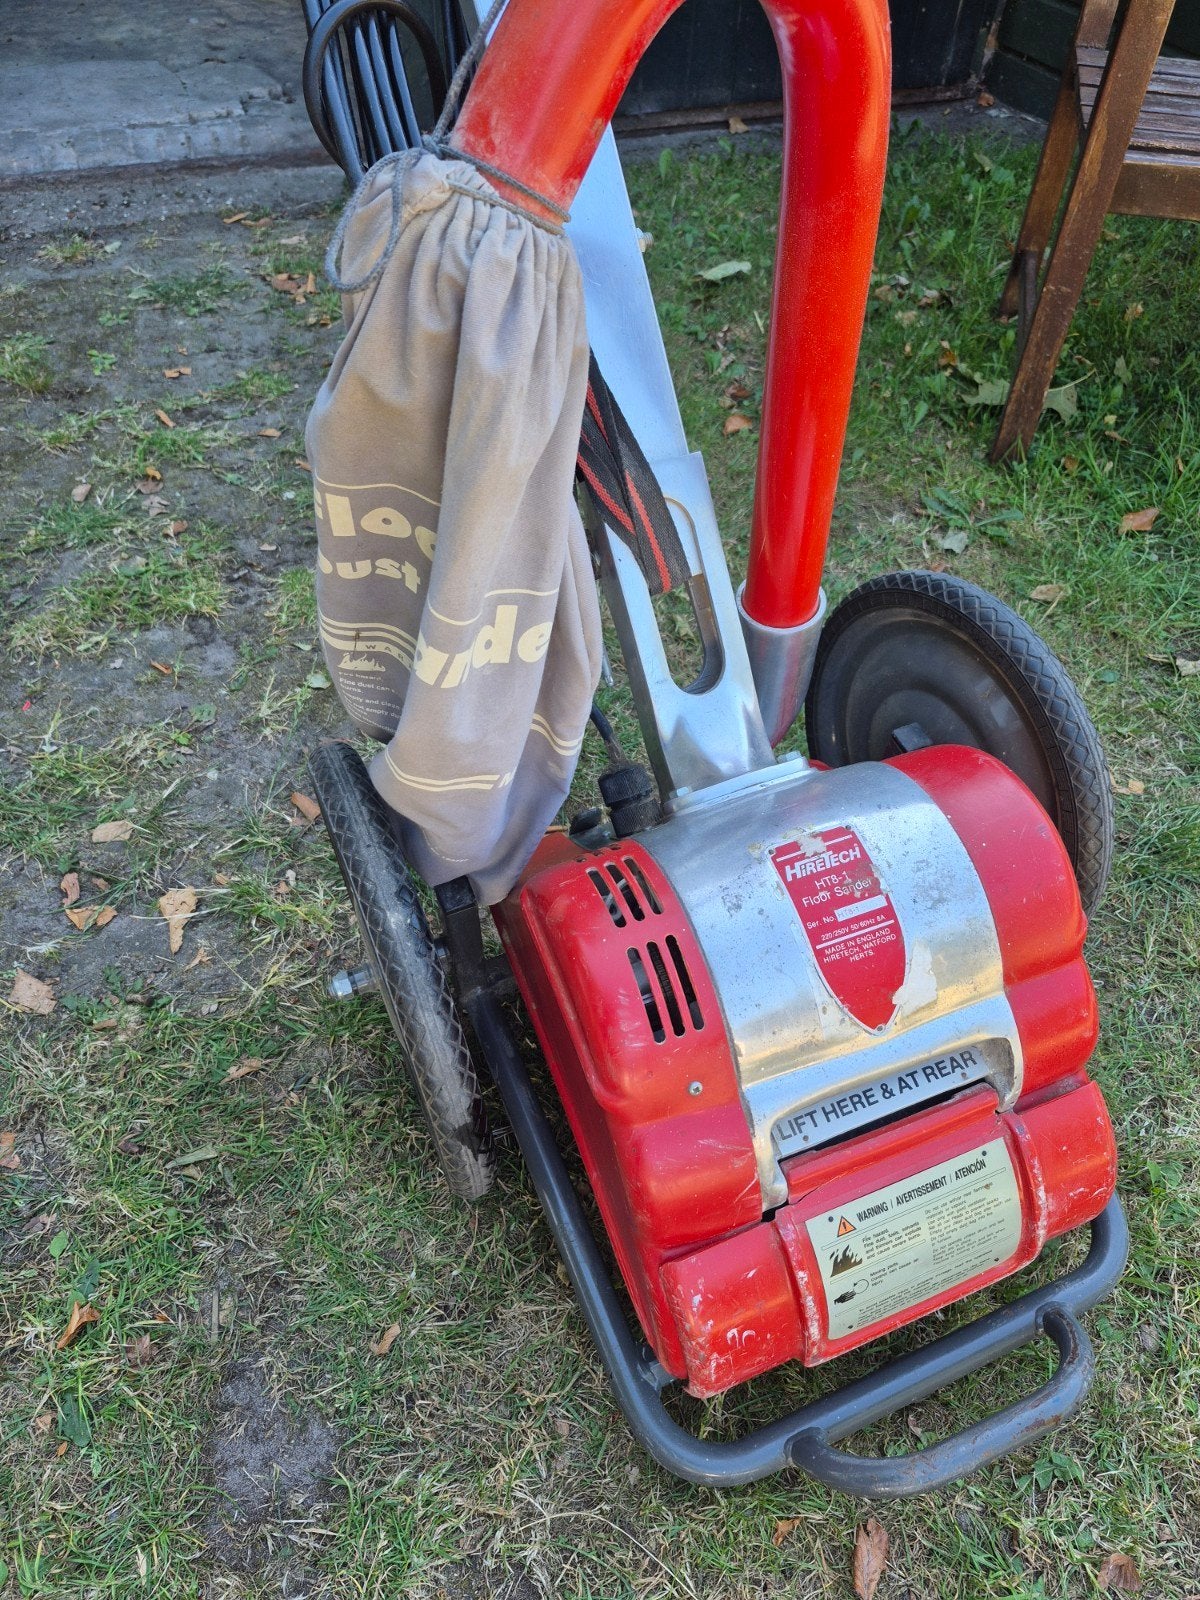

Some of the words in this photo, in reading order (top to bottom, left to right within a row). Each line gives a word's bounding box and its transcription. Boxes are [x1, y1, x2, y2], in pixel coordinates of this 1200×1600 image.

[814, 870, 850, 890] HT8-1
[802, 891, 832, 908] Floor
[834, 878, 872, 897] Sander
[806, 921, 822, 930] Ser.
[822, 915, 837, 924] No.
[821, 927, 849, 941] 220/250V
[850, 919, 875, 931] 50/60Hz
[824, 943, 847, 956] MADE
[847, 940, 855, 948] IN
[856, 928, 891, 945] ENGLAND
[862, 933, 897, 950] WATFORD
[776, 1110, 818, 1141] LIFT
[821, 1089, 879, 1123] HERE
[880, 1082, 896, 1100] &
[897, 1070, 920, 1095] AT
[923, 1050, 978, 1082] REAR
[856, 1201, 889, 1223] WARNING
[896, 1175, 948, 1206] AVERTISSEMENT
[955, 1158, 987, 1181] ATENCIÓN
